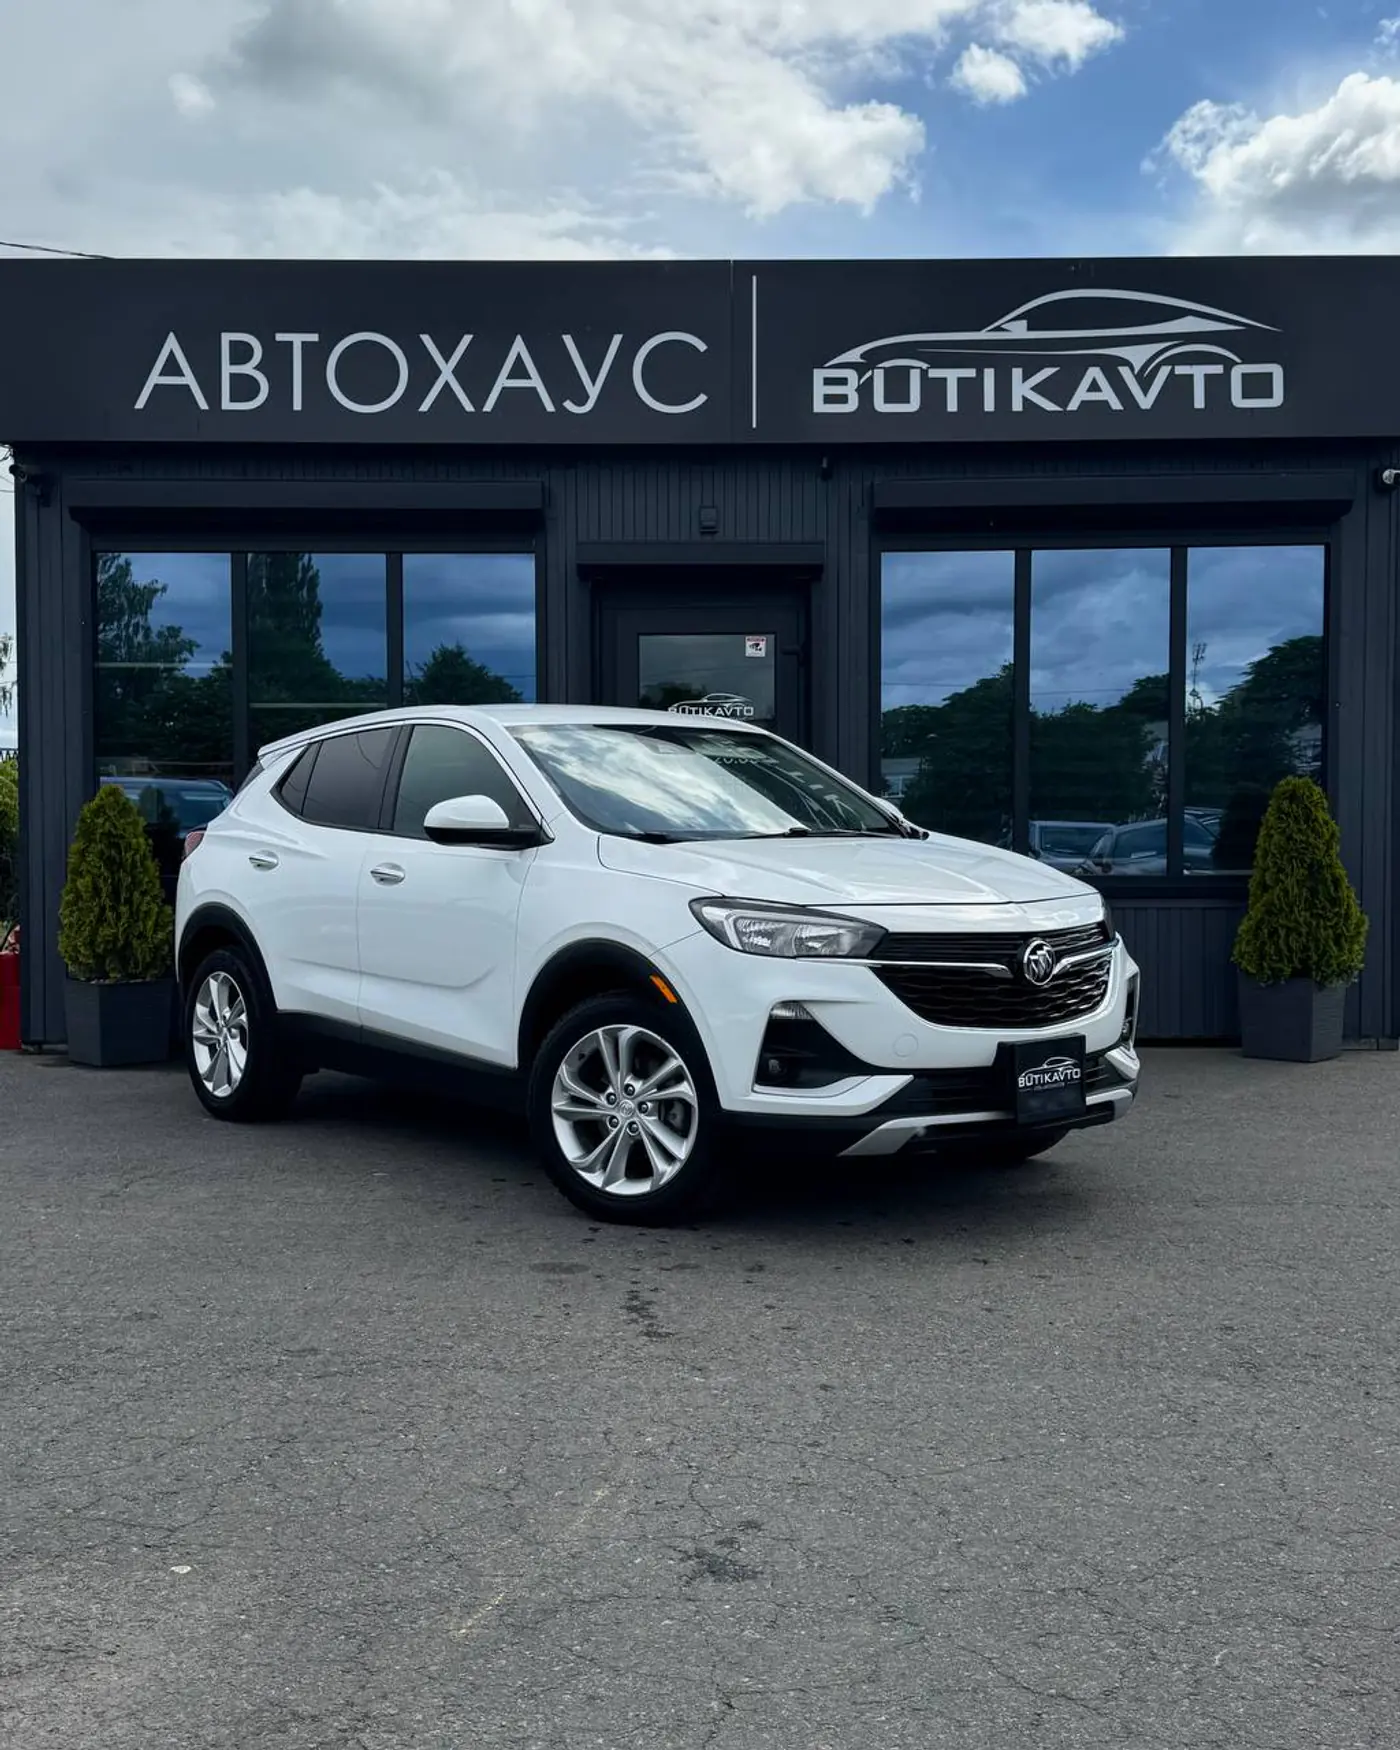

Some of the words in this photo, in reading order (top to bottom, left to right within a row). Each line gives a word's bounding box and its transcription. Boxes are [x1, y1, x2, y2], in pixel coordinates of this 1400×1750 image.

[134, 330, 709, 414] АВТОХАУС
[813, 363, 1284, 413] BUTIKAVTO
[1018, 1068, 1081, 1088] BUTIKAVTO
